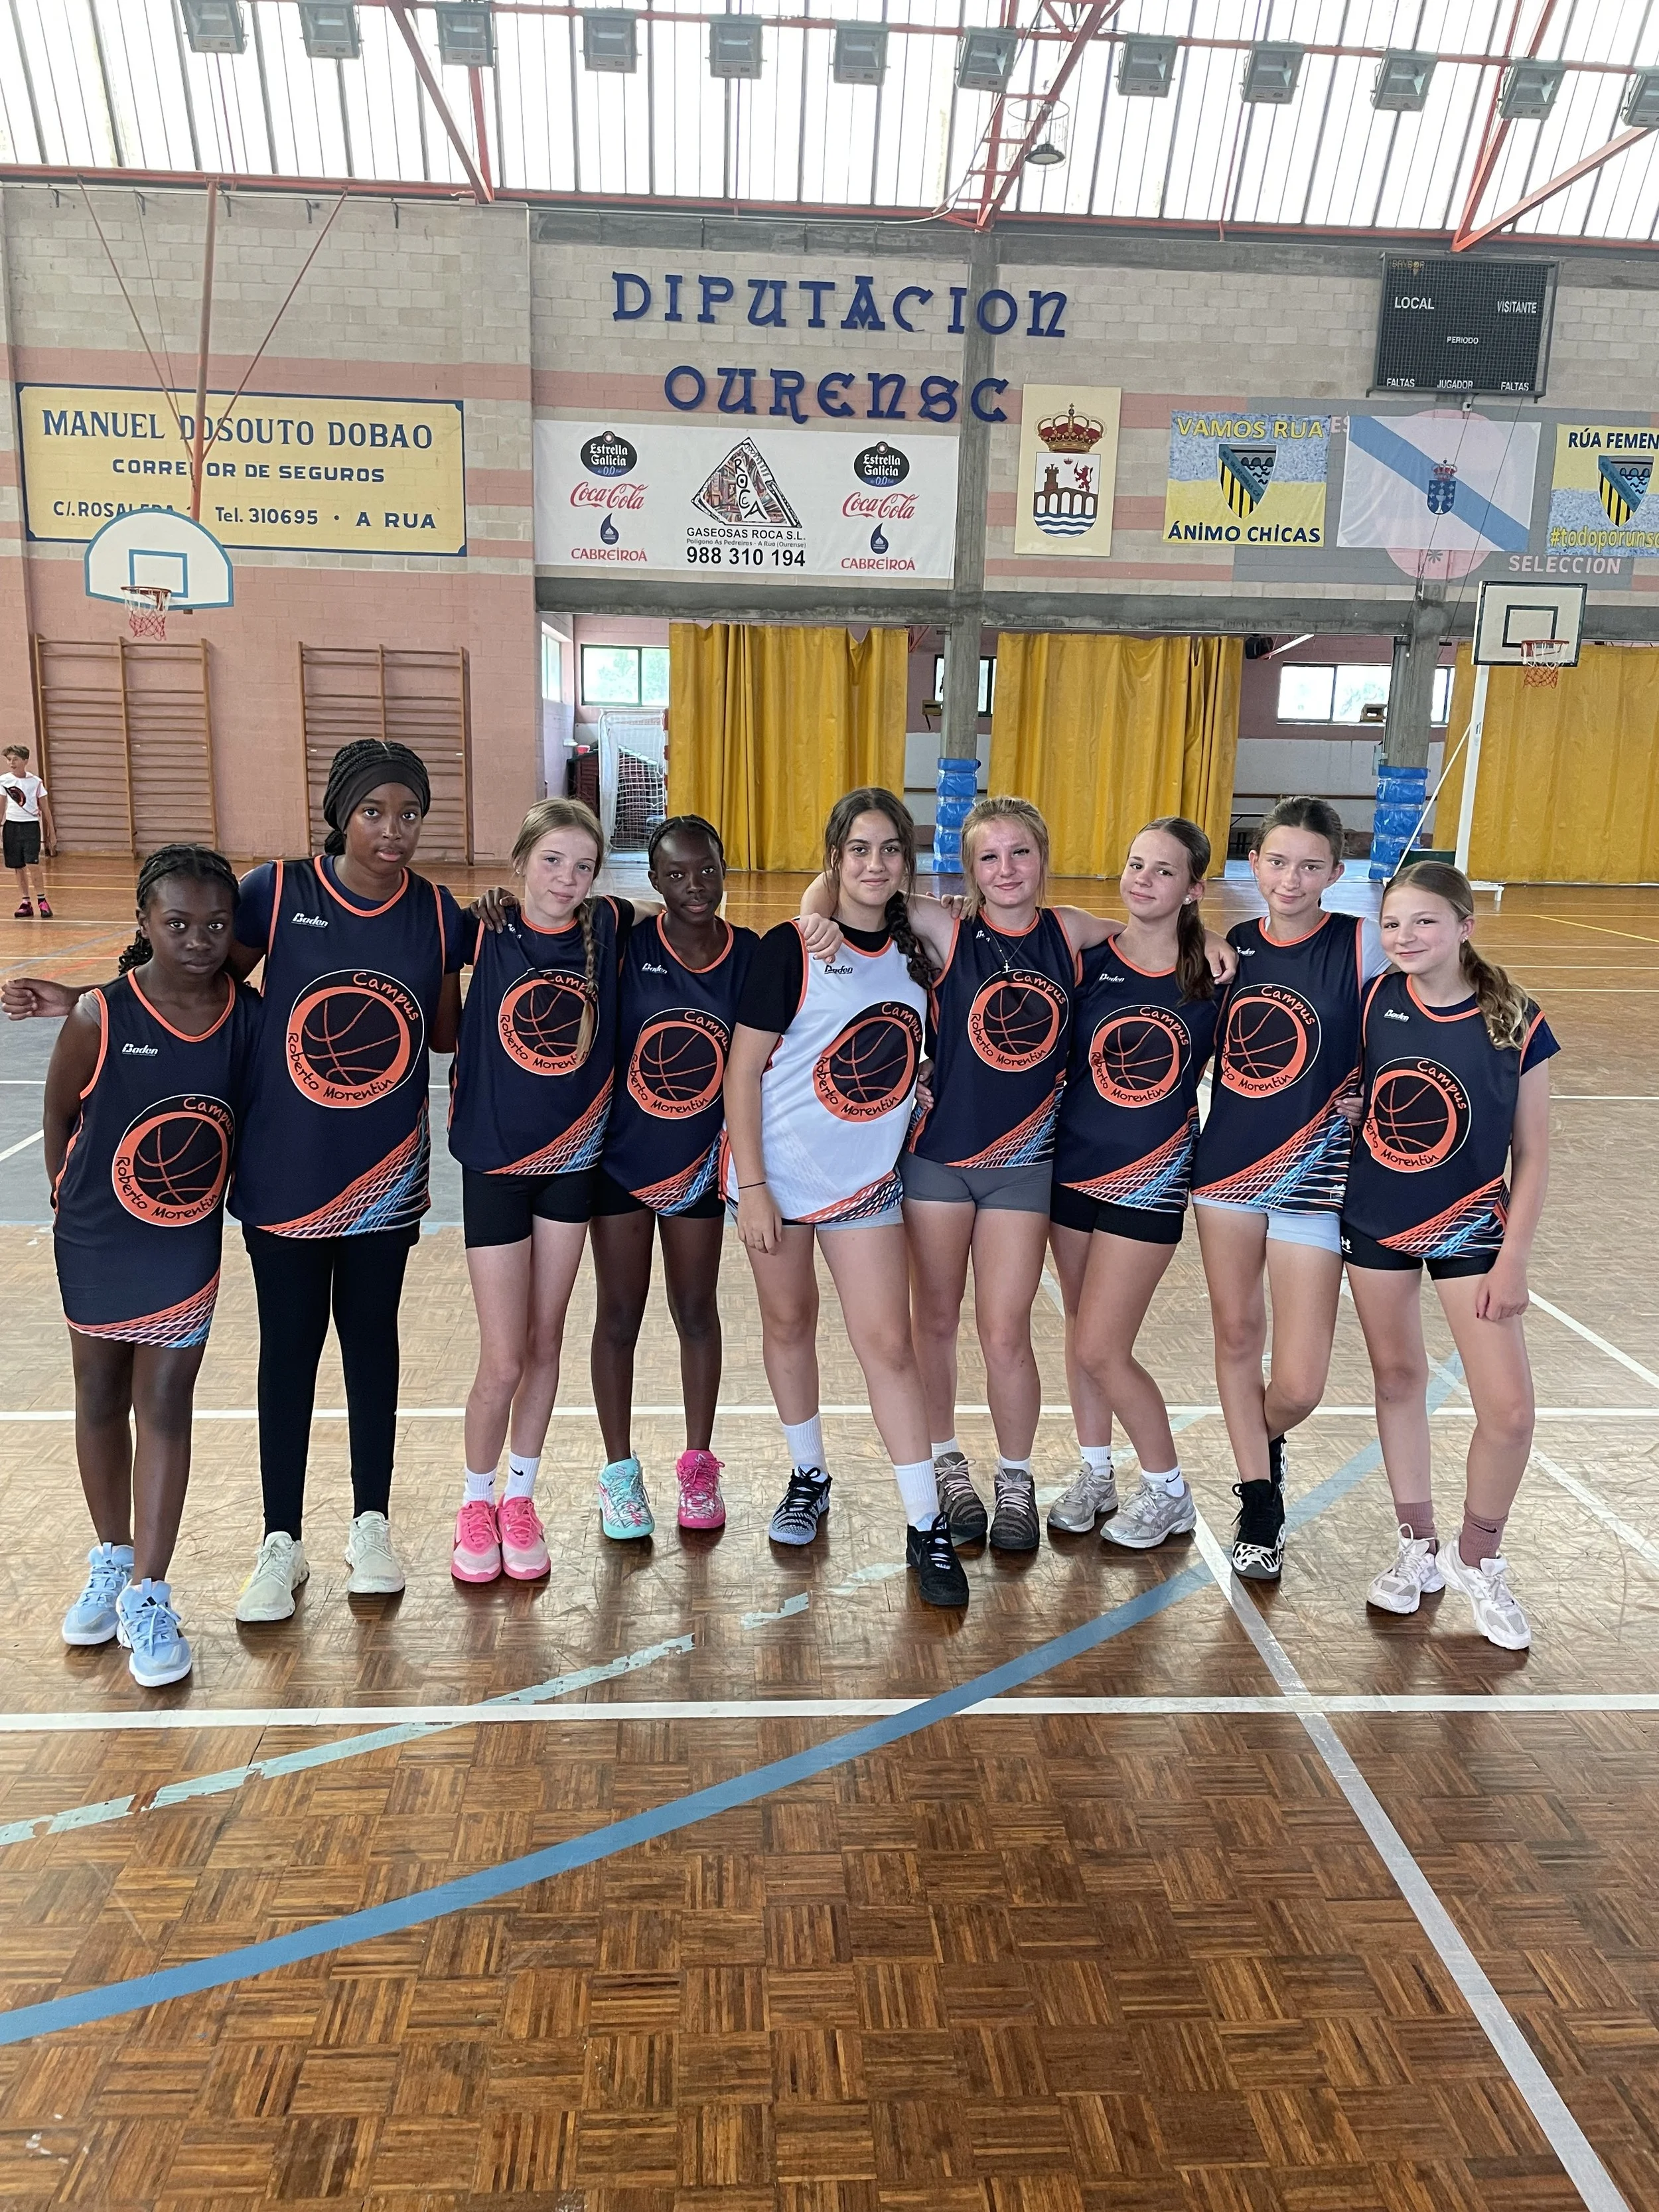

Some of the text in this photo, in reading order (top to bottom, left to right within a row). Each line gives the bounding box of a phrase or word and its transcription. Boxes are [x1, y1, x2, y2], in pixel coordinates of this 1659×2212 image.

[613, 271, 1067, 337] DIPUTACION
[1394, 297, 1434, 310] LOCAL
[1497, 301, 1537, 314] VISITANTE
[1447, 336, 1479, 344] PERIODO
[1386, 378, 1415, 388] FALTAS
[1437, 380, 1473, 389] JUGADOR
[1501, 382, 1530, 391] FALTAS
[42, 409, 433, 450] MANUEL DOSOUTO DOBAO
[1177, 417, 1324, 439] VAMOS RUA
[1568, 427, 1601, 449] RÚA
[589, 443, 628, 456] Estrella
[863, 454, 901, 465] Estrella
[112, 458, 385, 482] CORREOR DE SEGUROS
[591, 455, 626, 466] Galicia
[864, 465, 899, 477] Galicia
[570, 481, 650, 510] Coca-Cola
[734, 458, 768, 520] ROCA
[842, 492, 920, 519] Coca-Cola
[355, 511, 372, 527] A
[384, 512, 437, 529] RUA
[687, 527, 806, 540] GASEOSAS ROCA S.L.
[1247, 524, 1321, 543] CHICAS
[687, 546, 806, 567] 988 310 194
[1508, 555, 1621, 575] SELECCION
[292, 913, 328, 927] Baden
[352, 972, 419, 1021] Campus
[543, 972, 598, 1002] Camp
[1013, 971, 1066, 1004] Campus
[1261, 986, 1315, 1026] Campus
[1384, 1009, 1409, 1022] Baden
[684, 1011, 728, 1051] Campu
[881, 1002, 922, 1043] Campus
[1139, 1006, 1189, 1045] Campus
[500, 1014, 529, 1060] Roberto
[970, 1013, 1046, 1067] Roberto Morentin
[121, 1043, 159, 1055] Baden
[287, 1032, 395, 1102] Roberto Morentin
[816, 1057, 899, 1116] Roberto Morentin
[1238, 1073, 1293, 1091] Morentin
[1417, 1061, 1467, 1110] Campus
[650, 1097, 709, 1114] Morentin
[1111, 1088, 1166, 1102] Morentin
[182, 1096, 234, 1136] Campus
[1380, 1148, 1439, 1167] Morentin
[115, 1156, 219, 1220] Roberto Morentin
